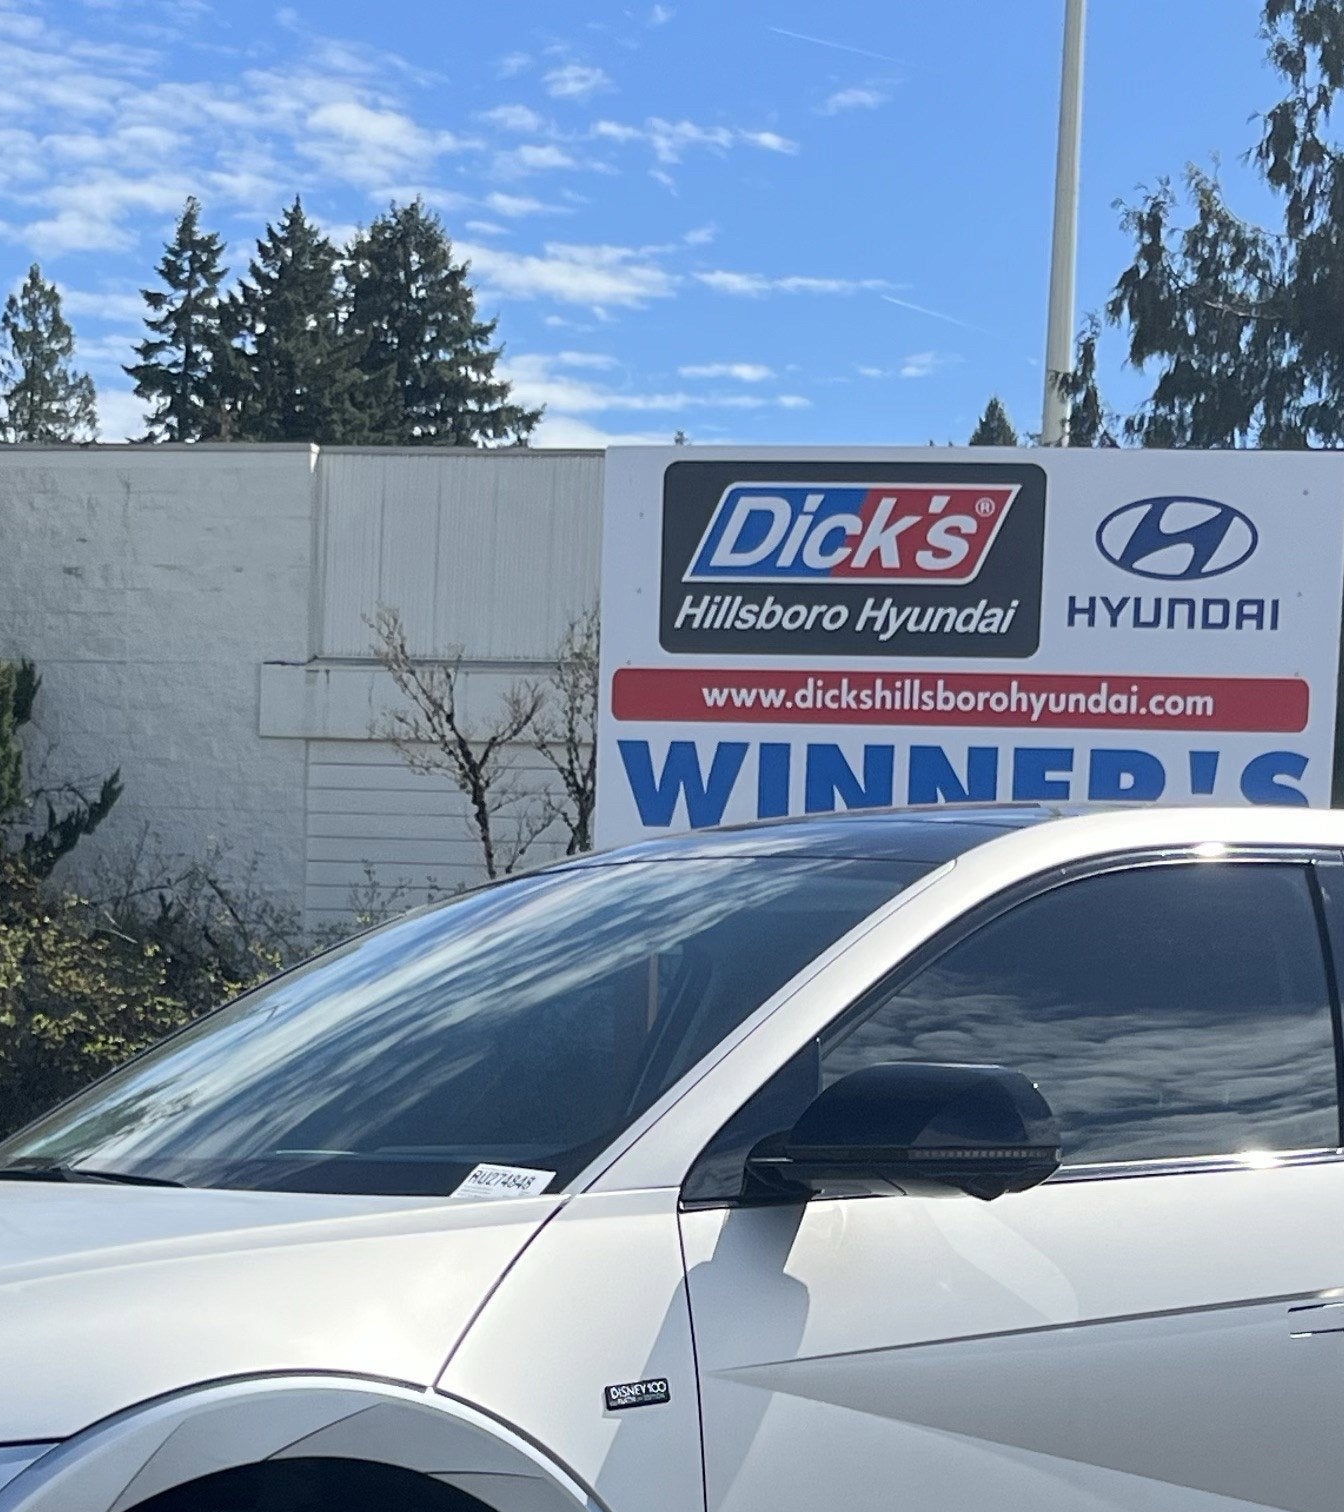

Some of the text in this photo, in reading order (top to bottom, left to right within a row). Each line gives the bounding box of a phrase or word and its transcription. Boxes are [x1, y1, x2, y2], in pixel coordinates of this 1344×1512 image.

[709, 493, 978, 571] Dick's
[674, 595, 1020, 641] Hillsboro Hyundai
[1067, 595, 1279, 631] HYUNDAI
[702, 679, 1214, 722] www.dickshillsborohyundai.com
[610, 1380, 667, 1400] DISNEY 100
